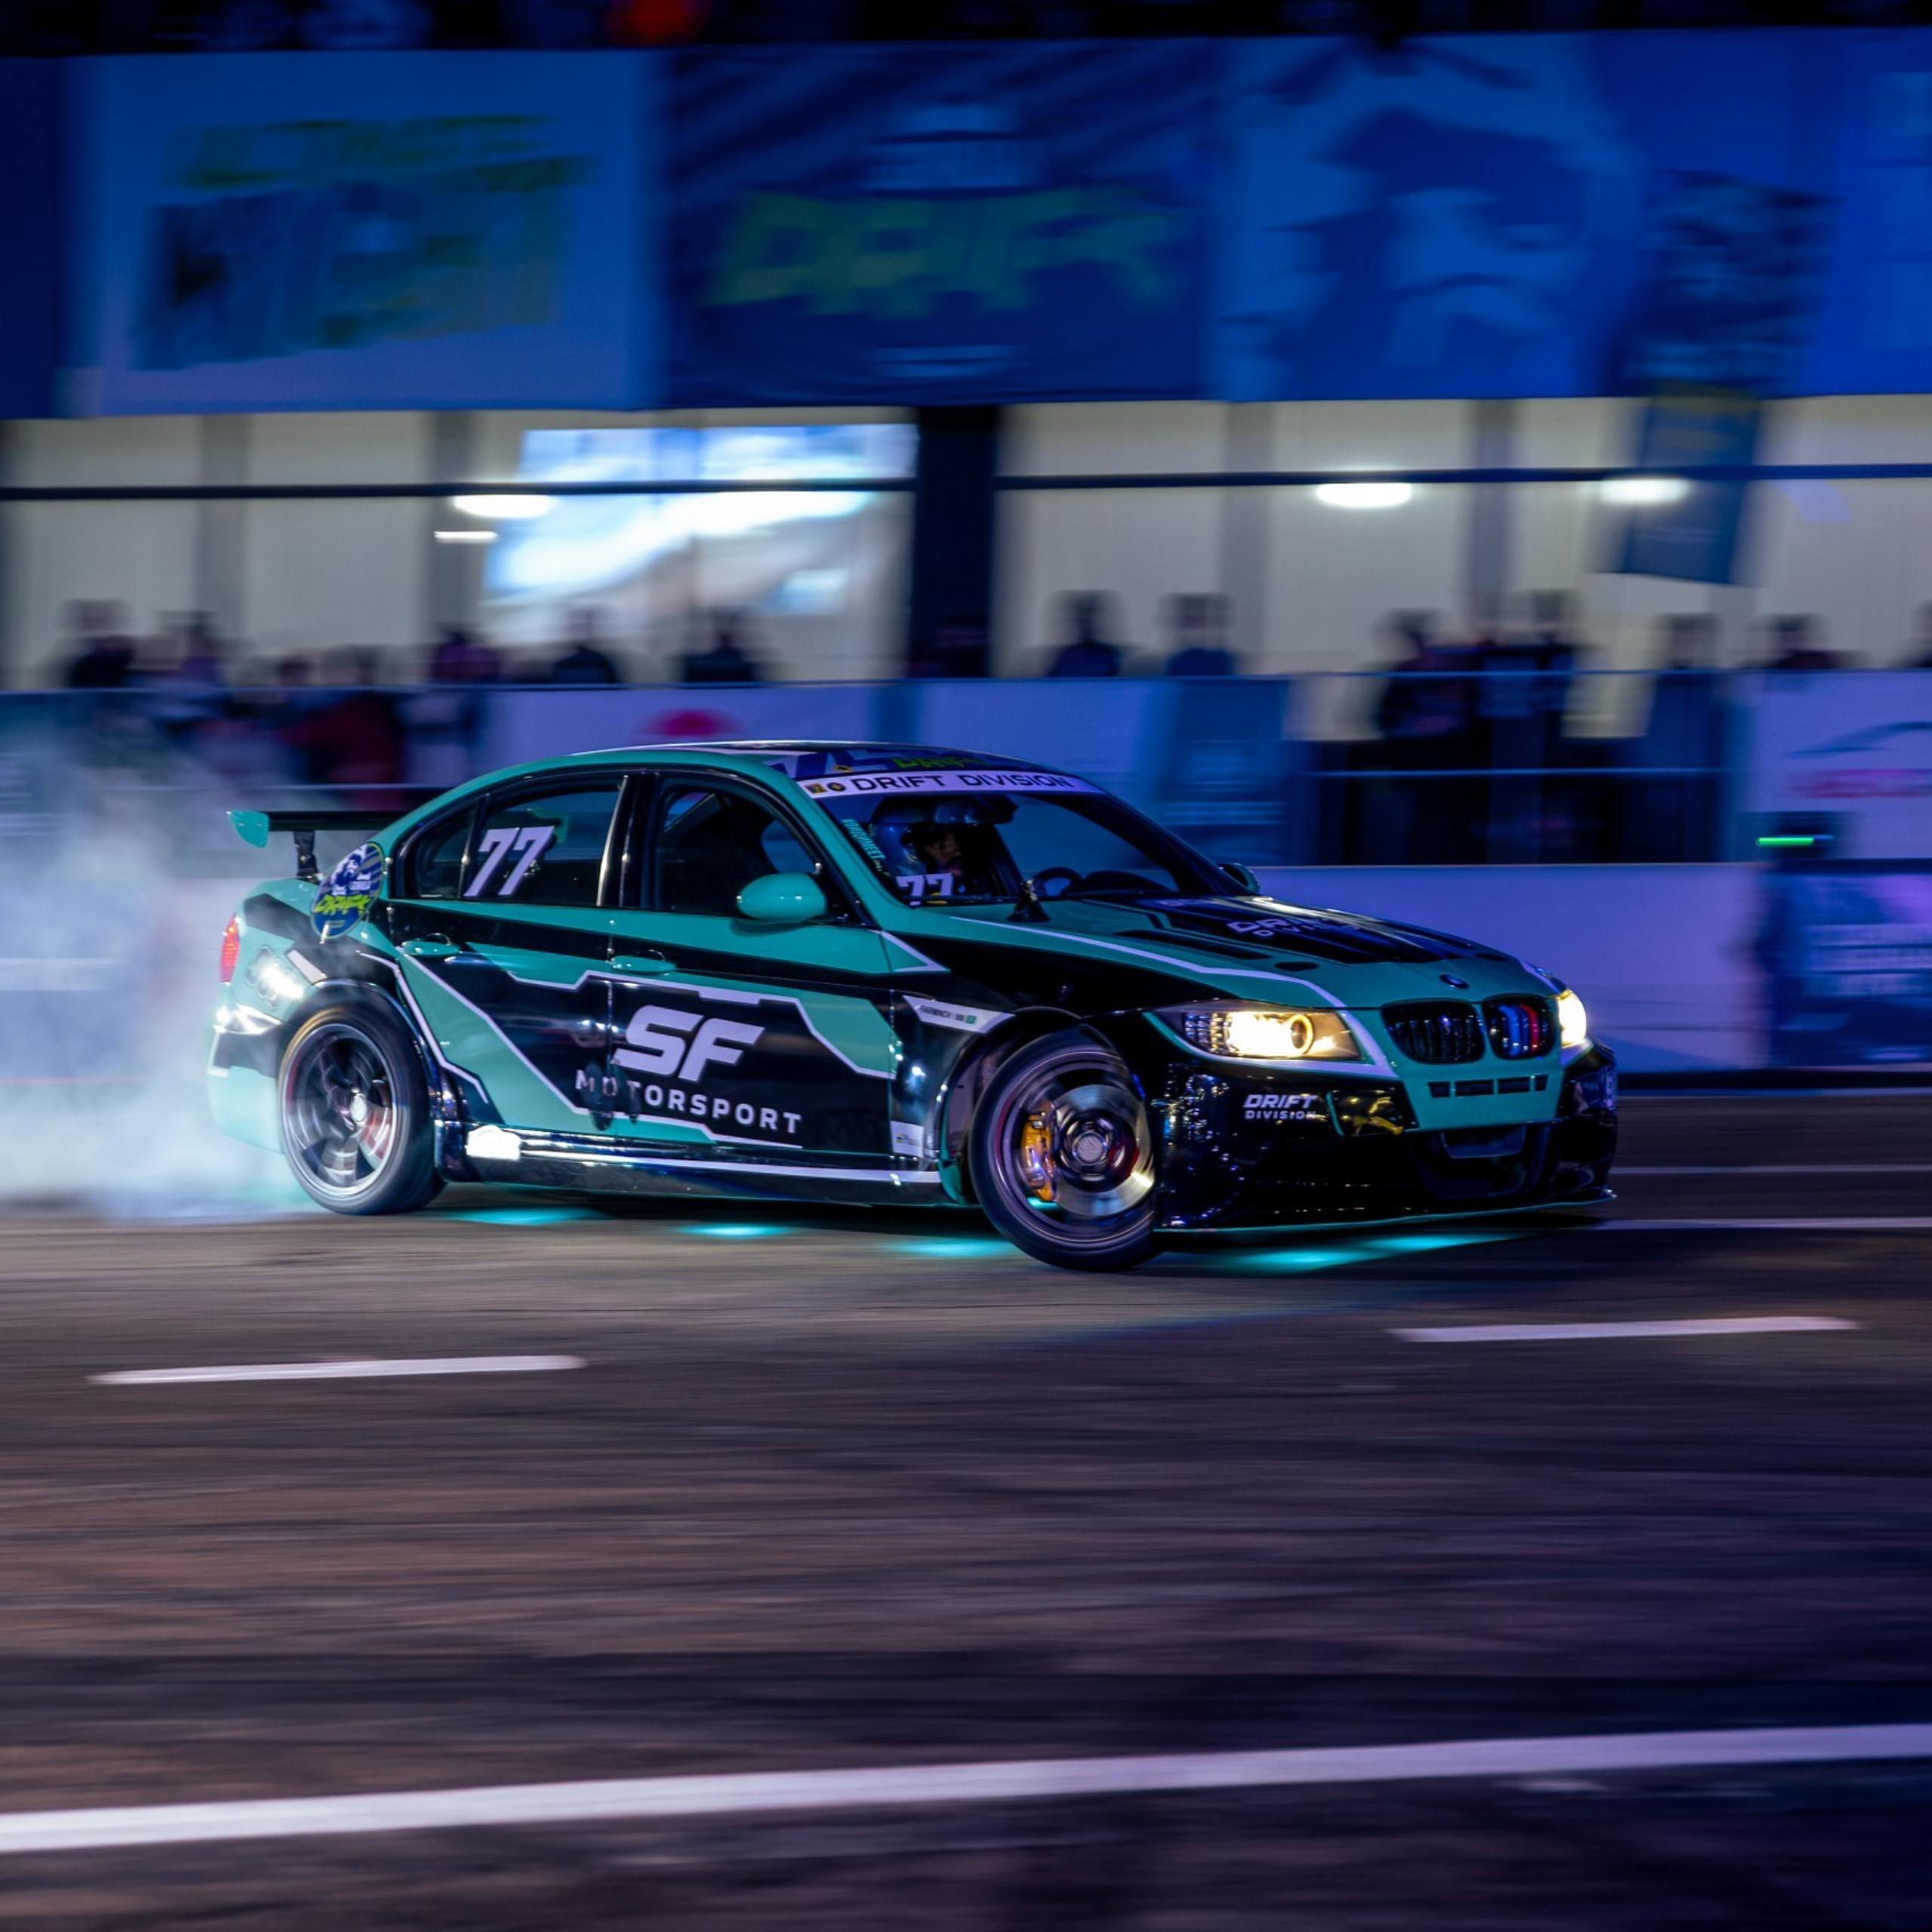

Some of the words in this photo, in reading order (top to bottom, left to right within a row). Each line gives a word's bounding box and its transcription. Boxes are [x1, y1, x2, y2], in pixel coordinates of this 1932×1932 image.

[851, 775, 945, 791] DRIFT
[957, 774, 1075, 788] DIVISION
[463, 826, 555, 897] 77
[896, 872, 953, 906] 77
[610, 1004, 765, 1082] SF
[575, 1069, 803, 1134] MOTORSPORT
[1243, 1094, 1318, 1109] DRIFT
